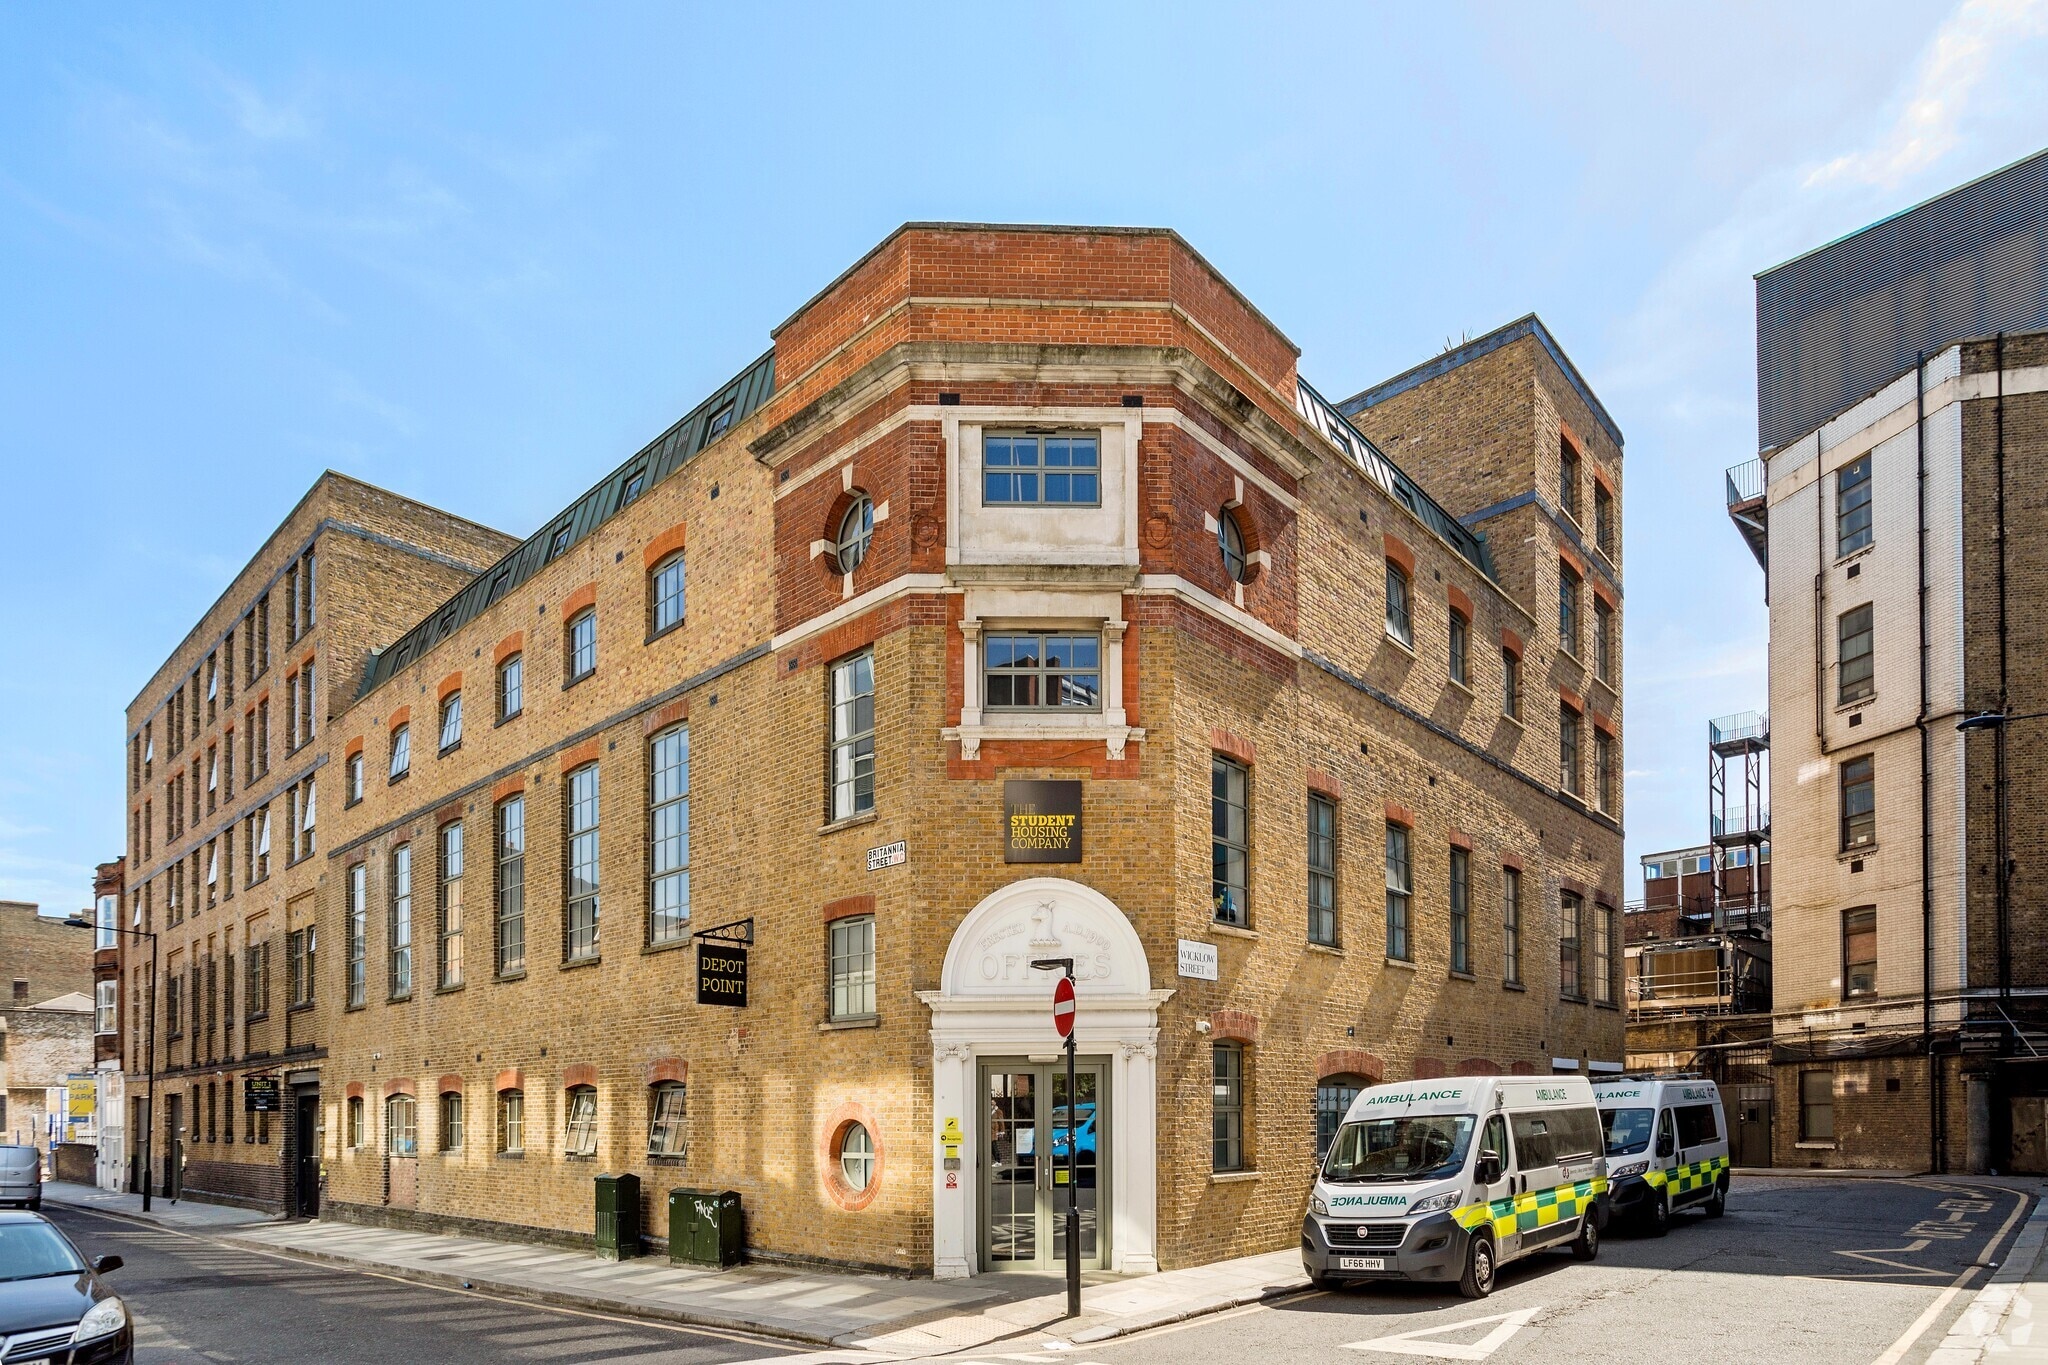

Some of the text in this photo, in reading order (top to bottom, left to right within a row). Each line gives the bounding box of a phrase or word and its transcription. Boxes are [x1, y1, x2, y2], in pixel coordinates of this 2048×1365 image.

[1011, 804, 1036, 815] THE
[1010, 815, 1075, 826] STUDENT
[1011, 826, 1068, 838] HOUSING
[1011, 838, 1072, 849] COMPANY
[868, 843, 904, 860] BRITANNIA
[979, 922, 1026, 951] ERECTED
[1180, 950, 1215, 963] WICKLOW
[702, 957, 744, 974] DEPOT
[1180, 963, 1205, 975] STREET
[702, 977, 744, 994] POINT
[1366, 1090, 1463, 1106] AMBULANCE
[1535, 1089, 1567, 1101] AMBULANCE
[1683, 1087, 1707, 1100] AMBULANCE
[1343, 1259, 1381, 1269] LF66 HHV
